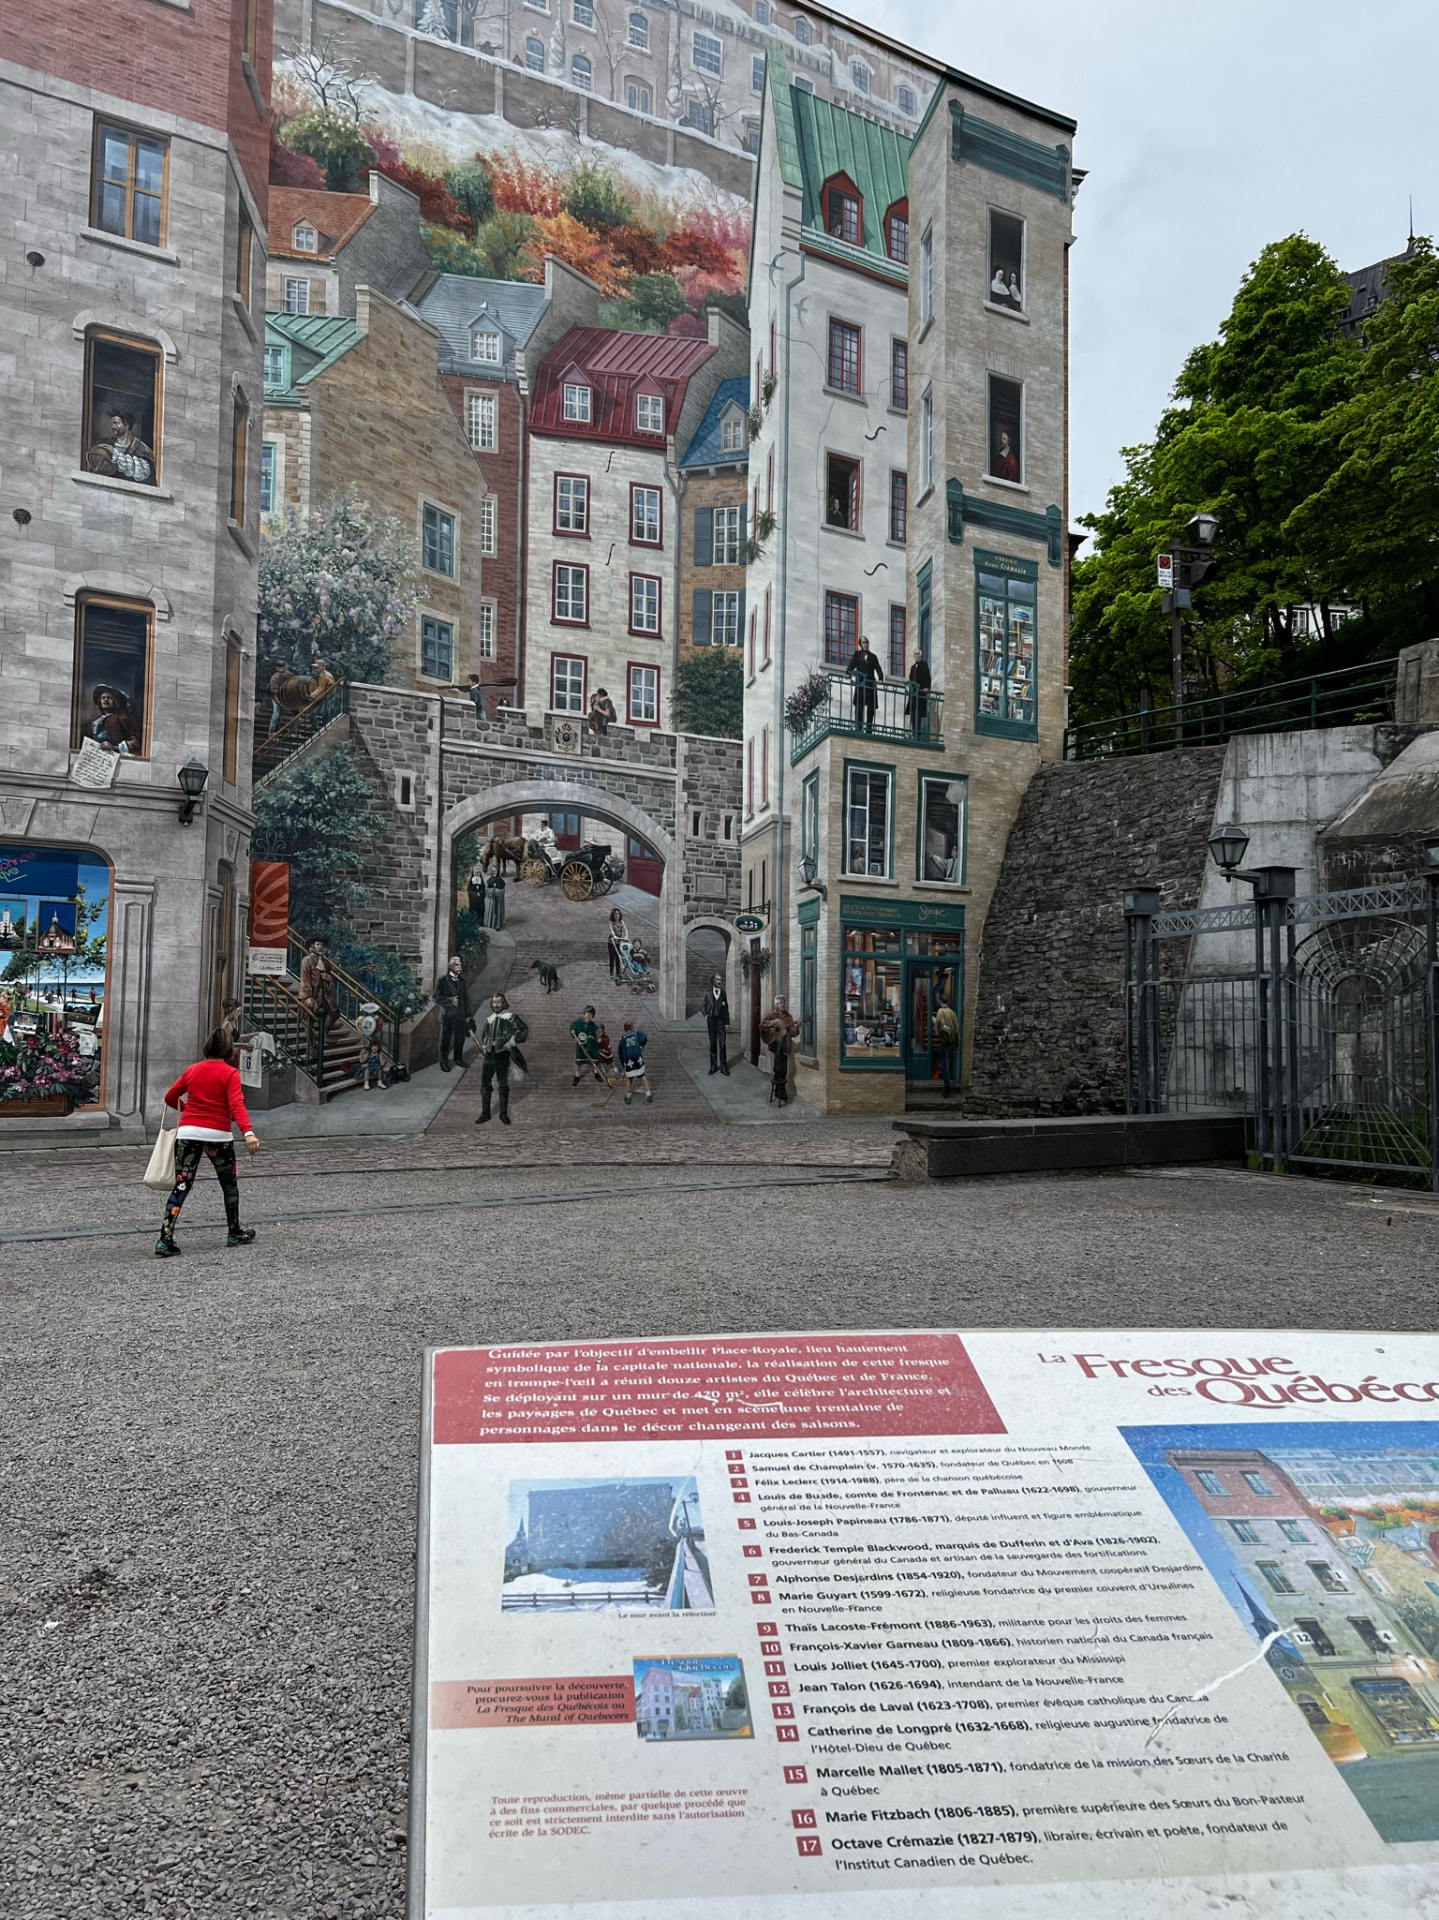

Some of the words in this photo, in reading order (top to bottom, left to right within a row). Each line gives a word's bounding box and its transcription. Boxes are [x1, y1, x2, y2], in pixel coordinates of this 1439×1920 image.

[626, 1037, 635, 1047] 26
[488, 1348, 541, 1358] Guidée
[545, 1351, 569, 1360] par
[574, 1347, 633, 1359] l'objectif
[637, 1346, 707, 1356] d'embellir
[712, 1345, 802, 1357] Place-Royale,
[806, 1344, 832, 1354] lieu
[836, 1343, 908, 1353] hautement
[1037, 1353, 1065, 1364] La
[1072, 1353, 1300, 1380] Fresque
[508, 1376, 595, 1389] trompe-l'œil
[614, 1376, 652, 1385] réuni
[657, 1375, 701, 1384] douze
[706, 1374, 758, 1384] artistes
[762, 1374, 781, 1383] du
[785, 1373, 837, 1385] Québec
[842, 1372, 855, 1382] et
[860, 1372, 876, 1381] de
[880, 1371, 933, 1381] France.
[1147, 1385, 1191, 1396] des
[480, 1425, 576, 1436] personnages
[581, 1422, 618, 1432] dans
[624, 1421, 636, 1431] le
[642, 1421, 683, 1431] décor
[688, 1420, 766, 1433] changeant
[771, 1419, 796, 1429] des
[801, 1418, 860, 1429] saisons.
[760, 1503, 797, 1513] général
[799, 1502, 811, 1510] de
[813, 1502, 823, 1510] la
[825, 1501, 901, 1510] Nouvelle-France
[776, 1572, 830, 1584] Alphonse
[833, 1570, 894, 1583] Desjardins
[896, 1569, 965, 1581] (1854-1920),
[967, 1567, 1017, 1578] fondateur
[1020, 1567, 1034, 1576] du
[1036, 1565, 1098, 1576] Mouvement
[1099, 1564, 1150, 1576] coopératif
[1151, 1562, 1206, 1575] Desjardins
[778, 1590, 813, 1600] Marie
[816, 1589, 858, 1601] Guyart
[860, 1588, 929, 1600] (1599-1672),
[931, 1586, 981, 1598] religieuse
[982, 1585, 1035, 1595] fondatrice
[1038, 1584, 1052, 1594] du
[1054, 1583, 1093, 1595] premier
[1096, 1582, 1137, 1592] couvent
[1138, 1580, 1194, 1591] d'Ursulines
[798, 1602, 882, 1613] Nouvelle-France
[790, 1640, 882, 1653] François-Xavier
[886, 1638, 939, 1649] Garneau
[941, 1636, 1014, 1649] (1809-1866),
[1016, 1635, 1064, 1645] historien
[1066, 1634, 1110, 1644] national
[1112, 1633, 1128, 1643] du
[1129, 1632, 1170, 1642] Canada
[1171, 1631, 1213, 1643] français
[1297, 1634, 1311, 1642] 12
[794, 1661, 827, 1671] Louis
[831, 1660, 868, 1670] Jolliet
[870, 1658, 945, 1671] (1645-1700),
[948, 1657, 990, 1669] premier
[993, 1655, 1055, 1668] explorateur
[1059, 1655, 1074, 1664] du
[1076, 1654, 1126, 1666] Mississipi
[467, 1685, 491, 1693] Pour
[495, 1683, 552, 1694] poursuivre
[555, 1683, 565, 1691] la
[568, 1681, 628, 1692] découverte,
[772, 1686, 787, 1694] 12
[799, 1682, 828, 1692] Jean
[830, 1681, 866, 1691] Talon
[869, 1679, 944, 1692] (1626-1694),
[947, 1678, 1003, 1688] intendant
[1005, 1677, 1020, 1686] de
[1022, 1677, 1033, 1686] la
[1035, 1674, 1124, 1686] Nouvelle-France
[475, 1696, 550, 1704] procurez-vous
[566, 1692, 625, 1702] publication
[494, 1705, 534, 1714] Fresque
[536, 1704, 554, 1712] des
[557, 1702, 608, 1712] Québécois
[506, 1715, 526, 1723] The
[529, 1714, 561, 1722] Mural
[577, 1712, 629, 1722] Quebecers
[811, 1742, 883, 1753] l'Hôtel-Dieu
[886, 1741, 902, 1752] de
[905, 1740, 951, 1753] Québec
[788, 1770, 804, 1779] 15
[816, 1765, 875, 1778] Marcelle
[879, 1764, 924, 1776] Mallet
[926, 1761, 1007, 1776] (1805-1871),
[1009, 1758, 1071, 1771] fondatrice
[1074, 1758, 1090, 1769] de
[1091, 1757, 1104, 1768] la
[1106, 1756, 1151, 1768] mission
[1153, 1755, 1174, 1766] des
[1175, 1753, 1214, 1765] Sœurs
[1215, 1753, 1231, 1764] de
[1232, 1752, 1245, 1763] la
[1246, 1750, 1290, 1762] Charité
[820, 1786, 828, 1796] à
[831, 1784, 880, 1798] Québec
[796, 1814, 813, 1824] 16
[825, 1810, 867, 1822] Marie
[871, 1808, 931, 1821] Fitzbach
[934, 1804, 1019, 1821] (1806-1885),
[1022, 1802, 1078, 1817] première
[1080, 1799, 1146, 1815] supérieure
[1149, 1798, 1171, 1809] des
[1172, 1796, 1211, 1808] Sœurs
[1213, 1796, 1231, 1807] du
[1232, 1793, 1305, 1806] Bon-Pasteur
[488, 1829, 518, 1838] écrite
[521, 1828, 534, 1837] de
[538, 1828, 547, 1836] la
[550, 1827, 591, 1836] SODEC.
[801, 1841, 817, 1851] 17
[831, 1837, 883, 1850] Octave
[886, 1834, 954, 1847] Crémazie
[957, 1830, 1041, 1847] (1827-1879),
[1043, 1828, 1093, 1843] libraire,
[1095, 1825, 1144, 1838] écrivain
[1146, 1825, 1161, 1836] et
[1163, 1823, 1204, 1838] poète,
[1206, 1820, 1268, 1833] fondateur
[1272, 1819, 1288, 1830] de
[835, 1858, 891, 1870] l'Institut
[894, 1856, 956, 1868] Canadien
[959, 1855, 975, 1866] de
[979, 1853, 1033, 1868] Québec.
